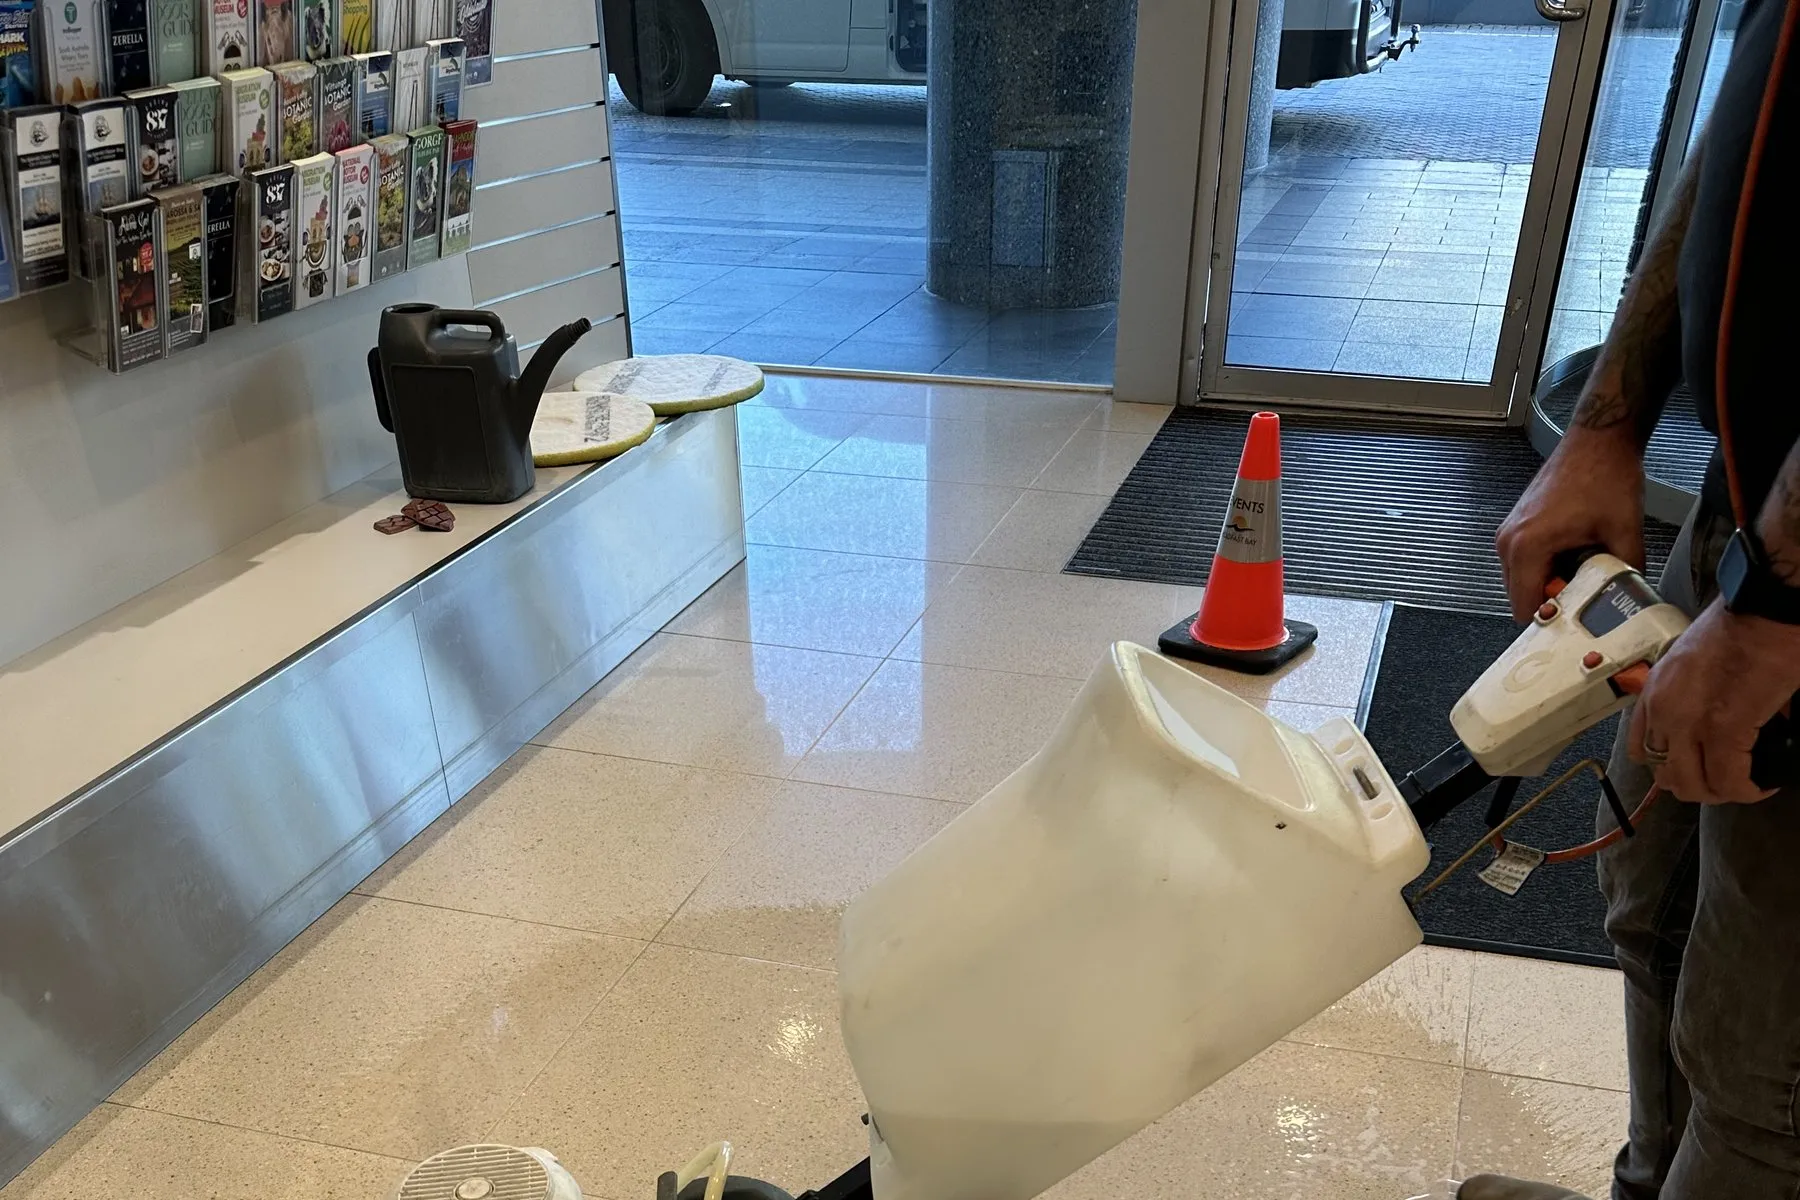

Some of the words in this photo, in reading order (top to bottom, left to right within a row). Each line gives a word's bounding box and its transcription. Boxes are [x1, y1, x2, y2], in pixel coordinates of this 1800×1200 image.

[112, 33, 143, 46] ZERELLA
[146, 108, 168, 132] 837
[266, 183, 285, 204] 837
[207, 220, 231, 235] ERELLA
[1231, 497, 1264, 514] VENTS
